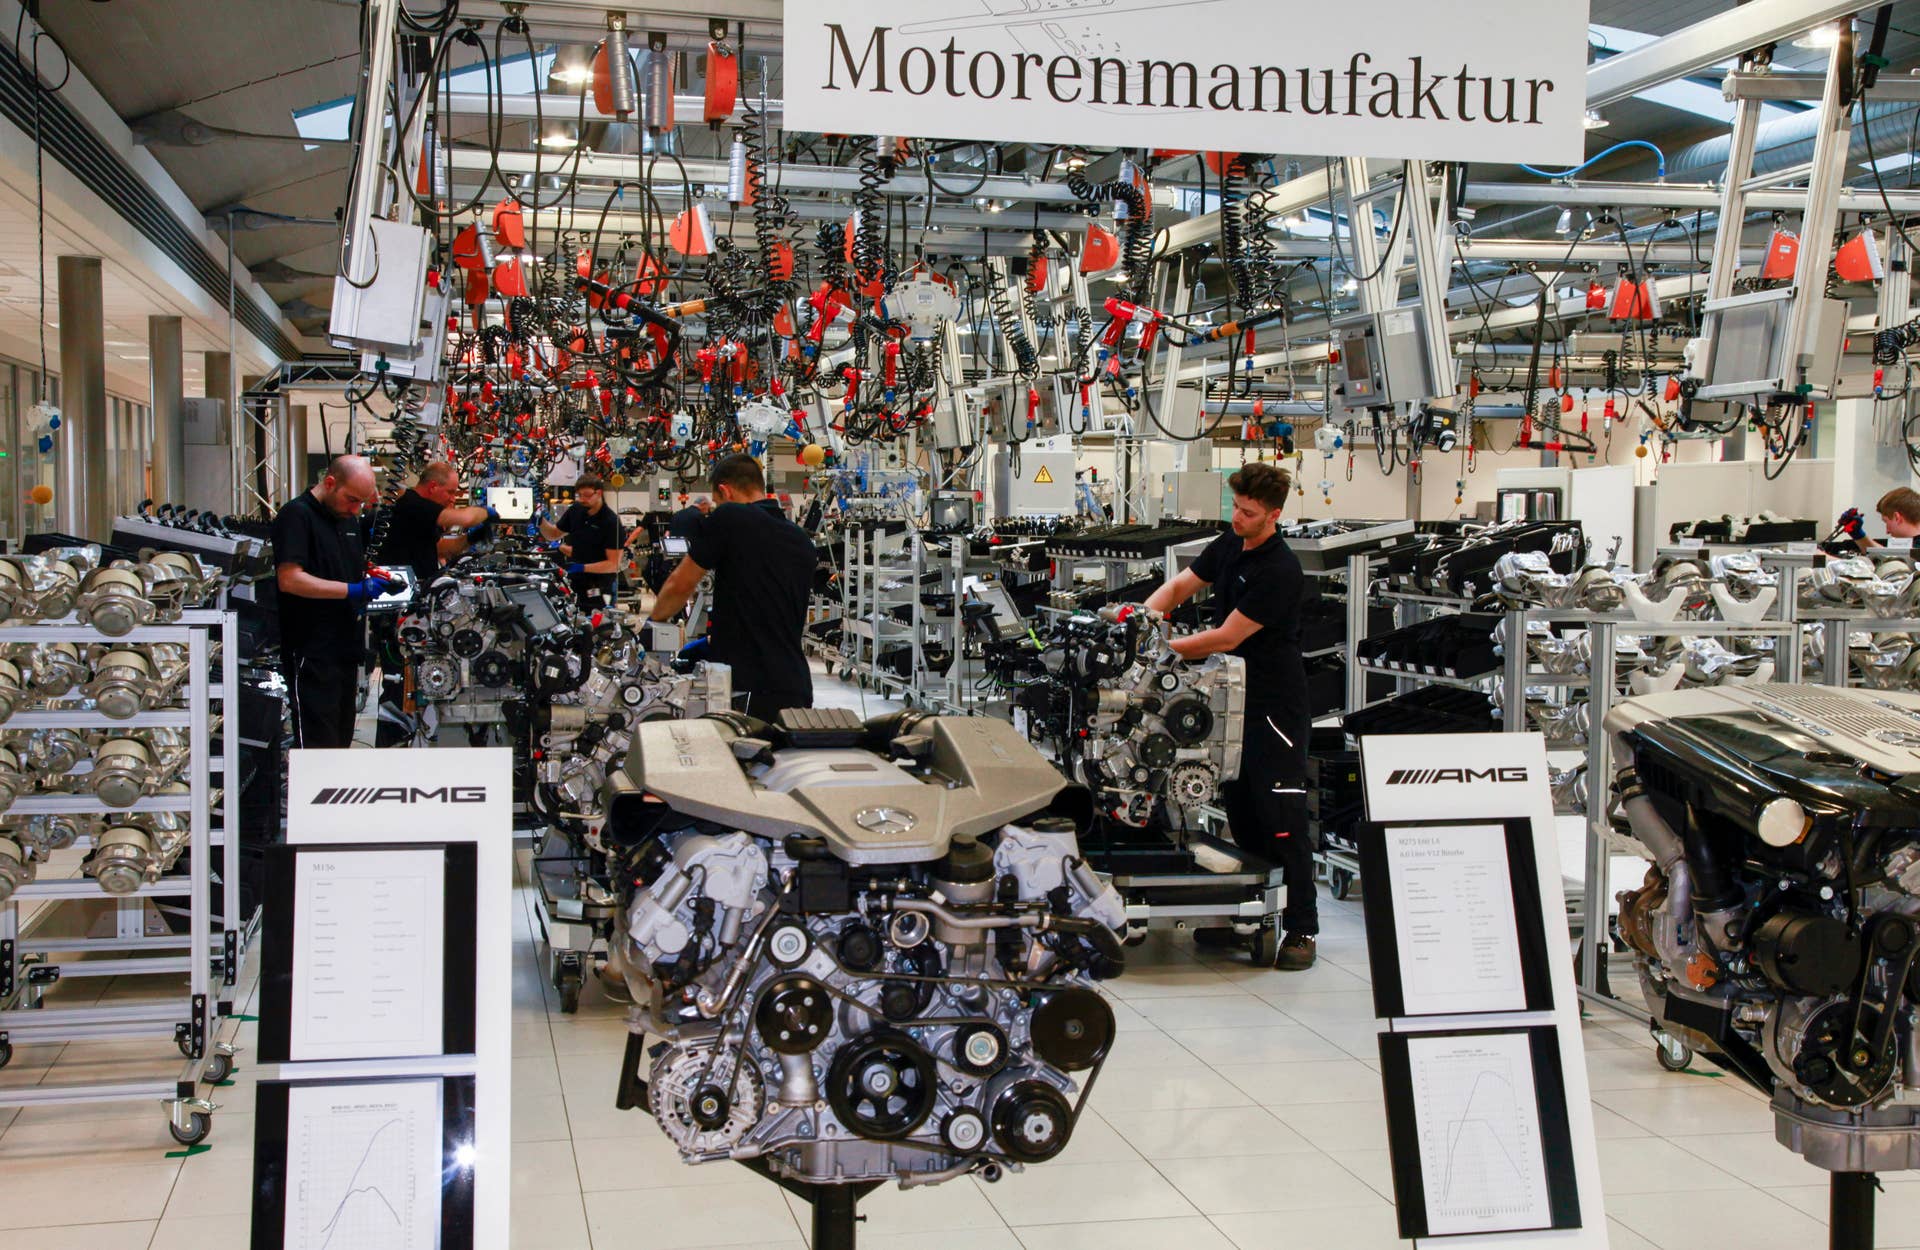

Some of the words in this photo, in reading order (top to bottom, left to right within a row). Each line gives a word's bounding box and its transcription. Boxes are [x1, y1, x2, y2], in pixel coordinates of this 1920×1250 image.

[821, 23, 1554, 125] Motorenmanufaktur
[1431, 767, 1528, 783] AMG
[367, 787, 486, 803] AMG
